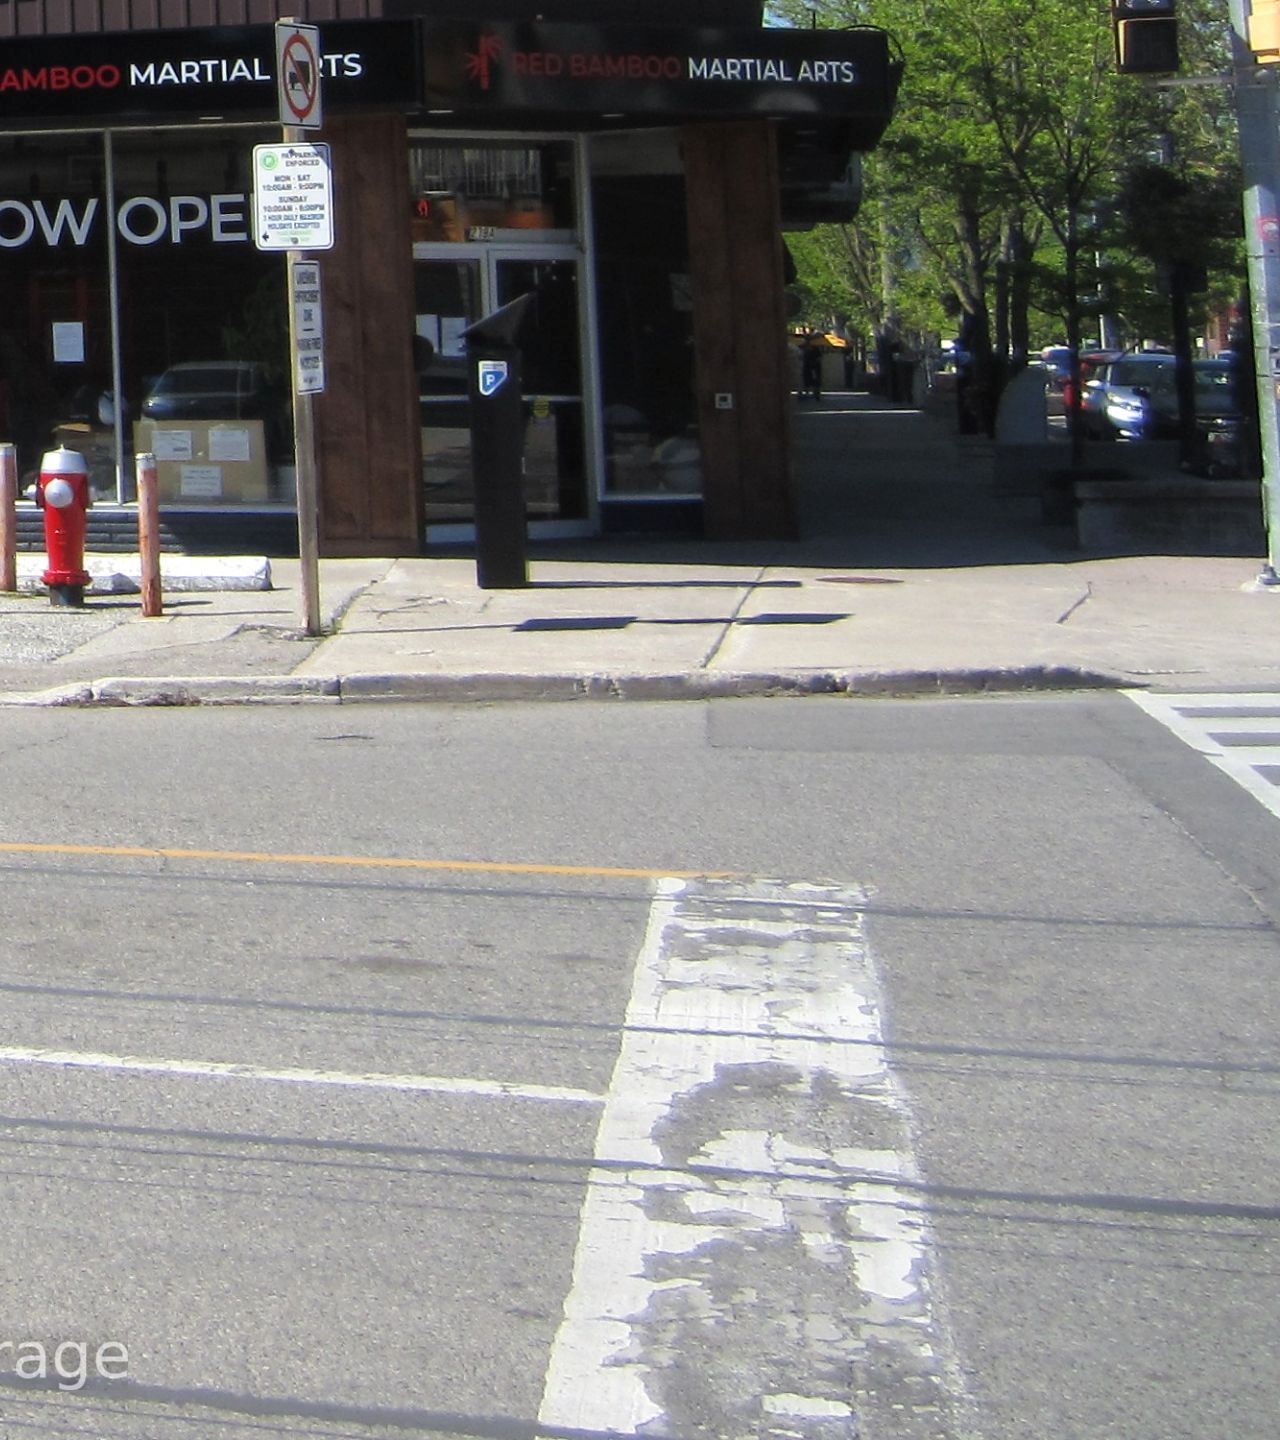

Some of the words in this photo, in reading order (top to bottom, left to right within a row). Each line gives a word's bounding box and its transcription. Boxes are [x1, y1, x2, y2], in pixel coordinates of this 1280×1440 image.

[129, 57, 271, 87] MARTIAL
[511, 51, 562, 76] RED
[569, 53, 681, 79] BAMBOO
[688, 57, 793, 82] MARTIAL
[798, 60, 855, 83] ARTS
[117, 192, 256, 245] OPE
